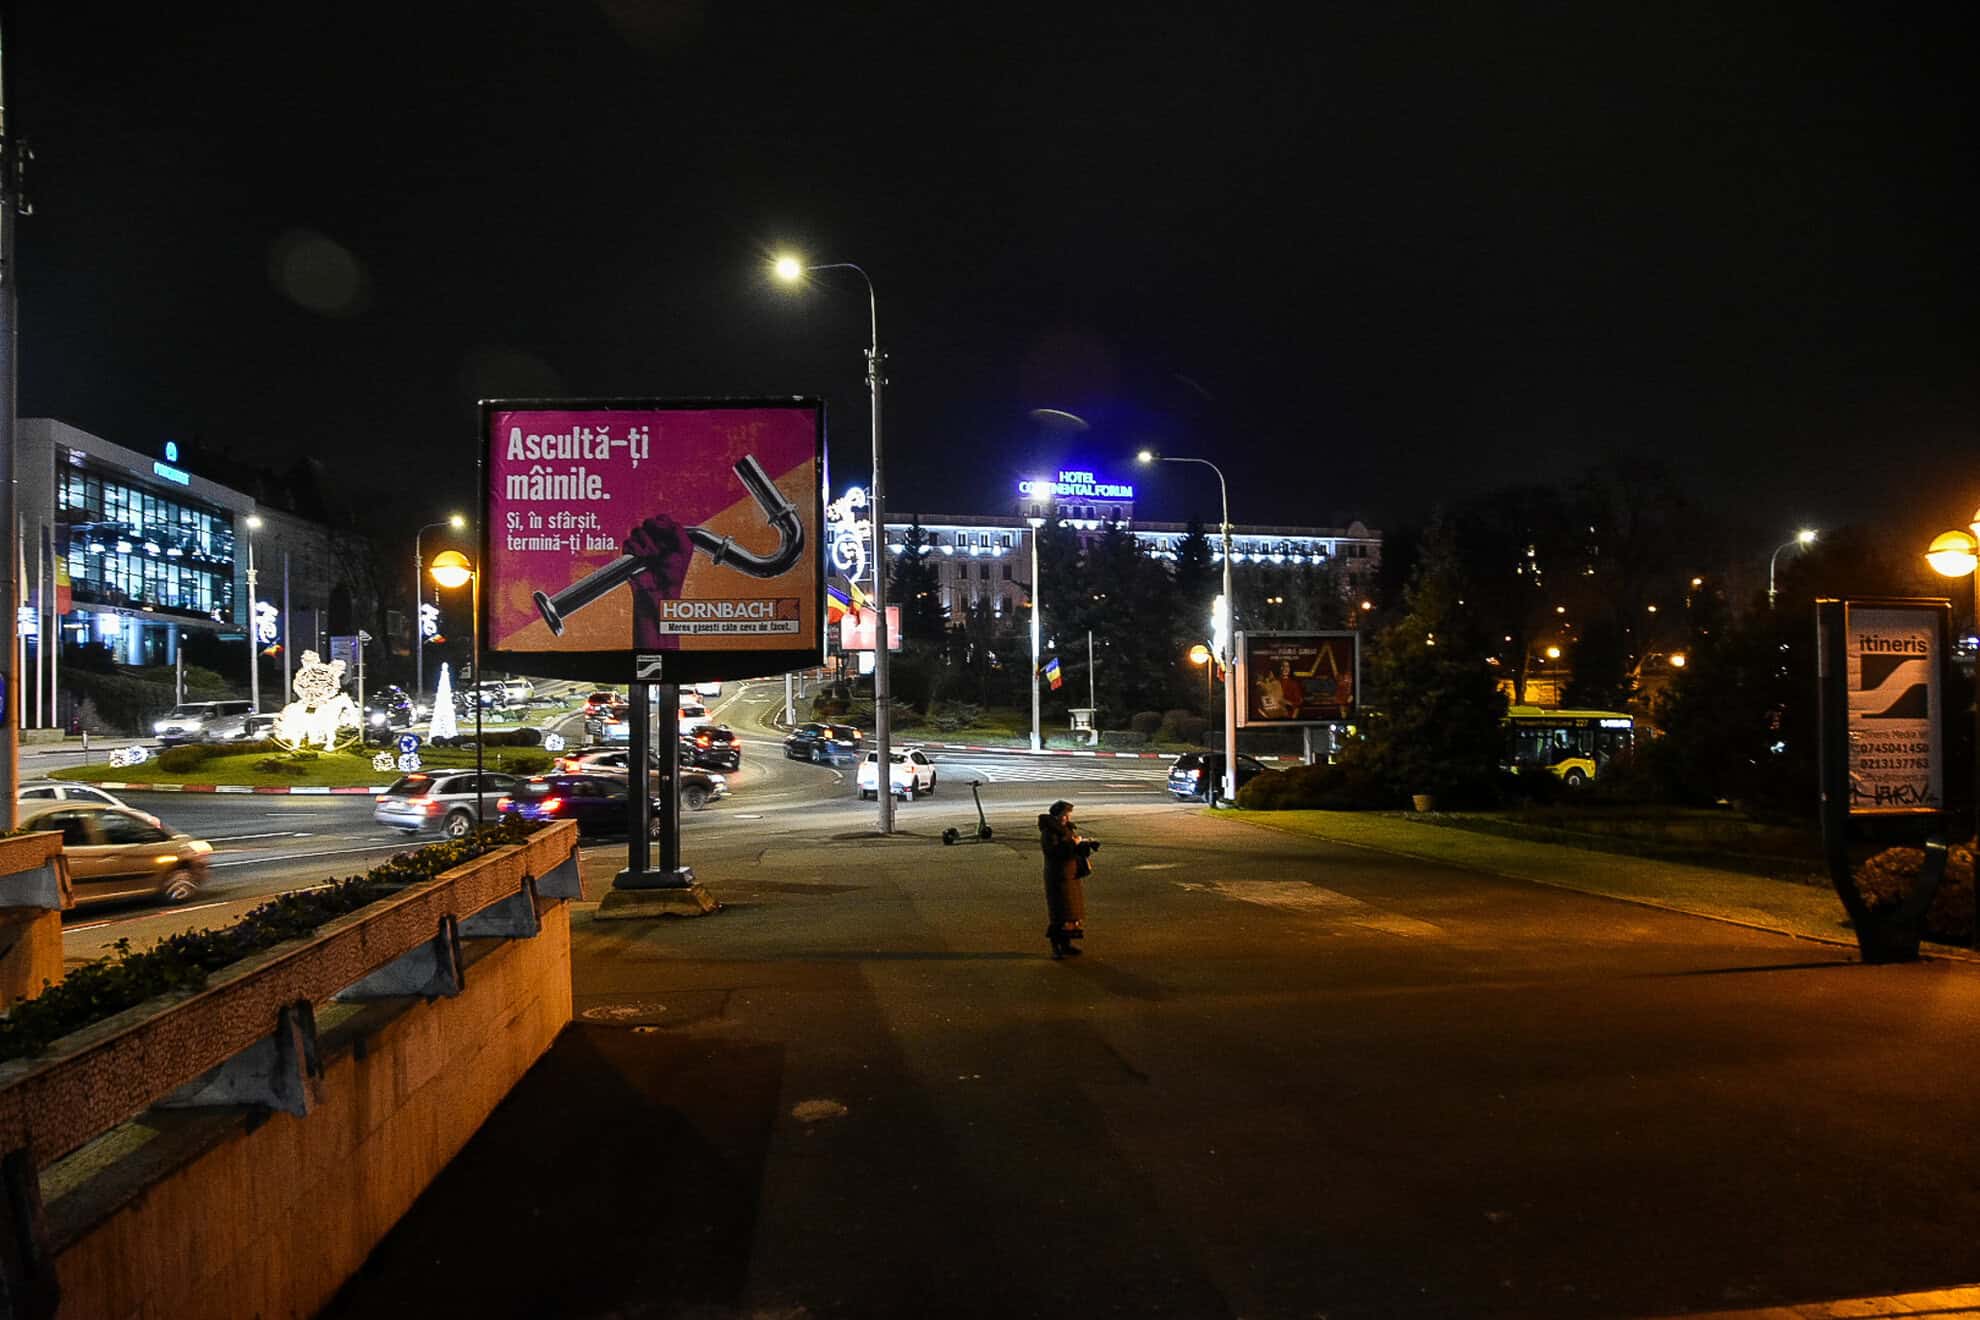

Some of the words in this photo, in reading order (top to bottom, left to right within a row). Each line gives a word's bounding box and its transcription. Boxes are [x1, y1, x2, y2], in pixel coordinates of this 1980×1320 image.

[507, 426, 649, 468] Ascultă-ți
[507, 465, 611, 500] mâinile.
[1059, 471, 1097, 484] HOTEL
[1095, 484, 1133, 497] FORUM
[528, 511, 542, 529] în
[586, 533, 619, 551] baia.
[663, 602, 773, 618] HORNBACH
[1859, 634, 1927, 653] itineris
